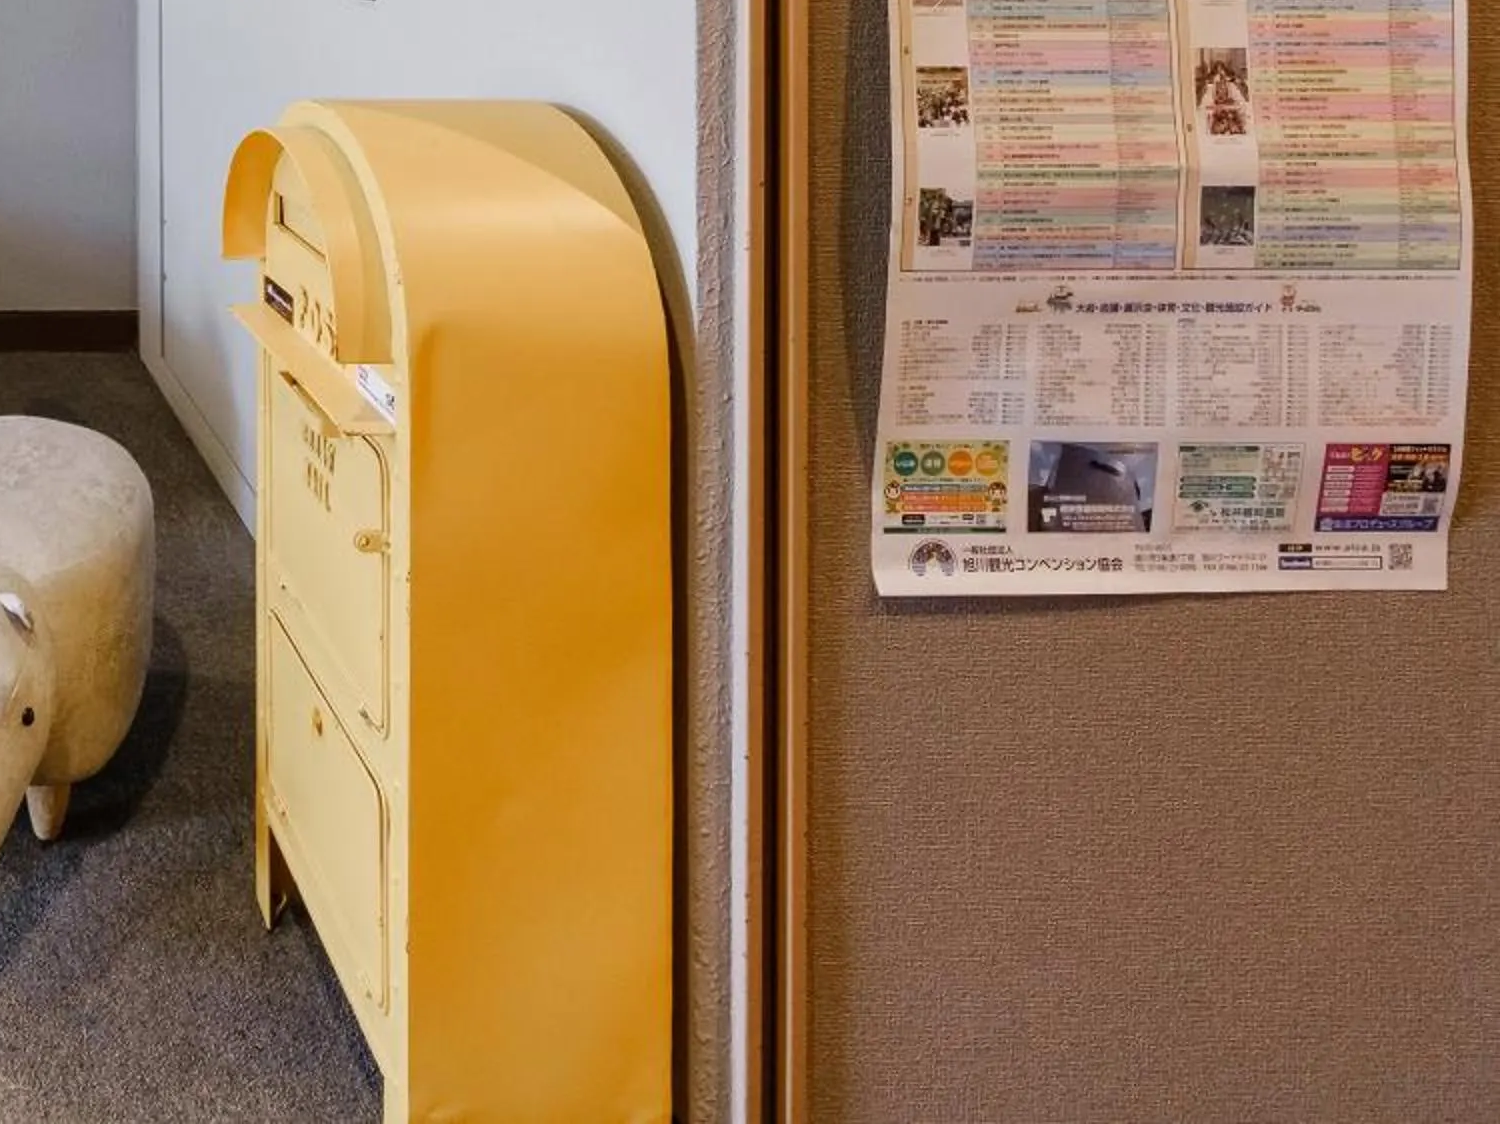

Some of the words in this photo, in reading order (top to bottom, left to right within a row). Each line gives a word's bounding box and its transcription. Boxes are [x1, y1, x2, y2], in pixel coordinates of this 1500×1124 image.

[962, 557, 1124, 573] 旭川観光コンベンション協会
